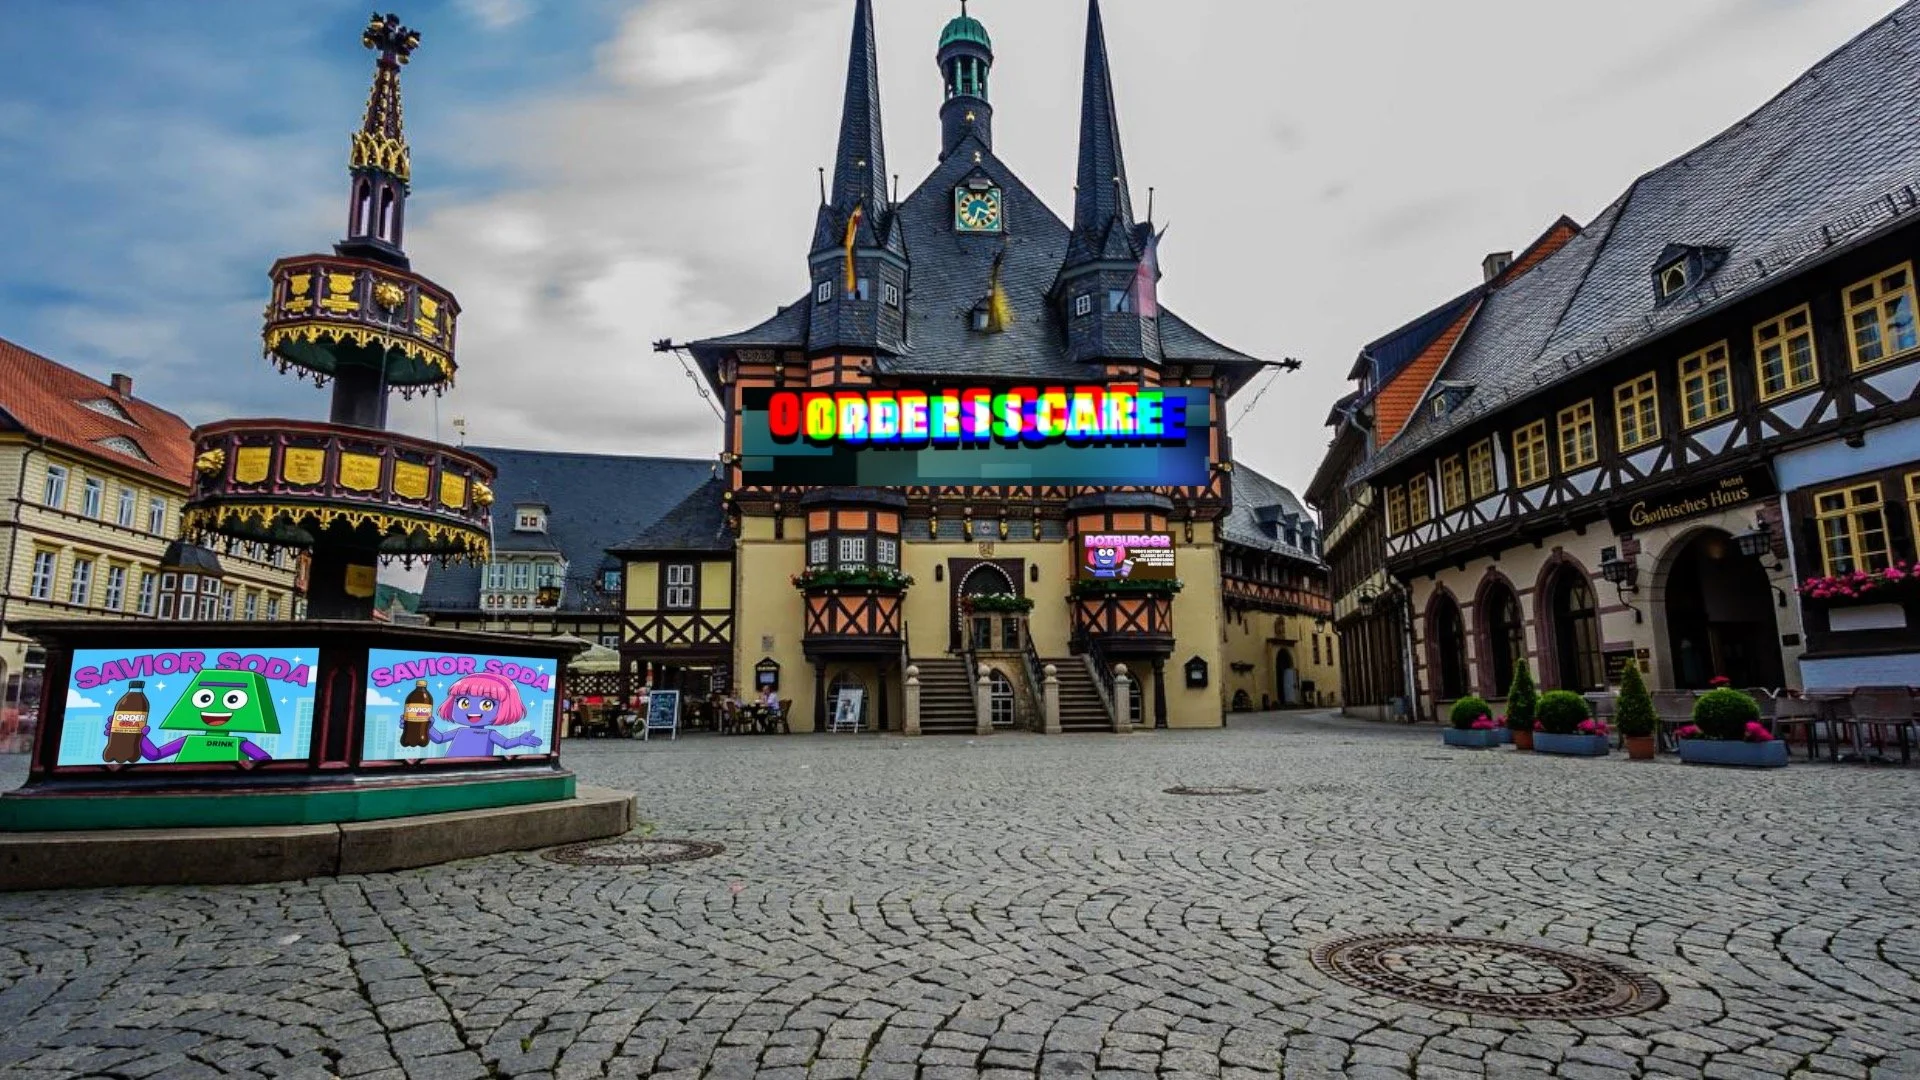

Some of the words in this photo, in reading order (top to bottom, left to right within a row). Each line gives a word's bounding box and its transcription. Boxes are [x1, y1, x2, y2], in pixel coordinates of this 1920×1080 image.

[768, 389, 964, 443] ORDER
[1033, 387, 1187, 443] CARE
[1630, 498, 1708, 525] Gothisches
[1710, 486, 1750, 507] Haus
[75, 651, 205, 689] SAVIOR
[216, 651, 310, 687] SODA
[371, 656, 477, 688] SAVIOR
[484, 659, 551, 692] SODA
[116, 714, 145, 722] ORDER
[206, 740, 233, 748] DRINK
